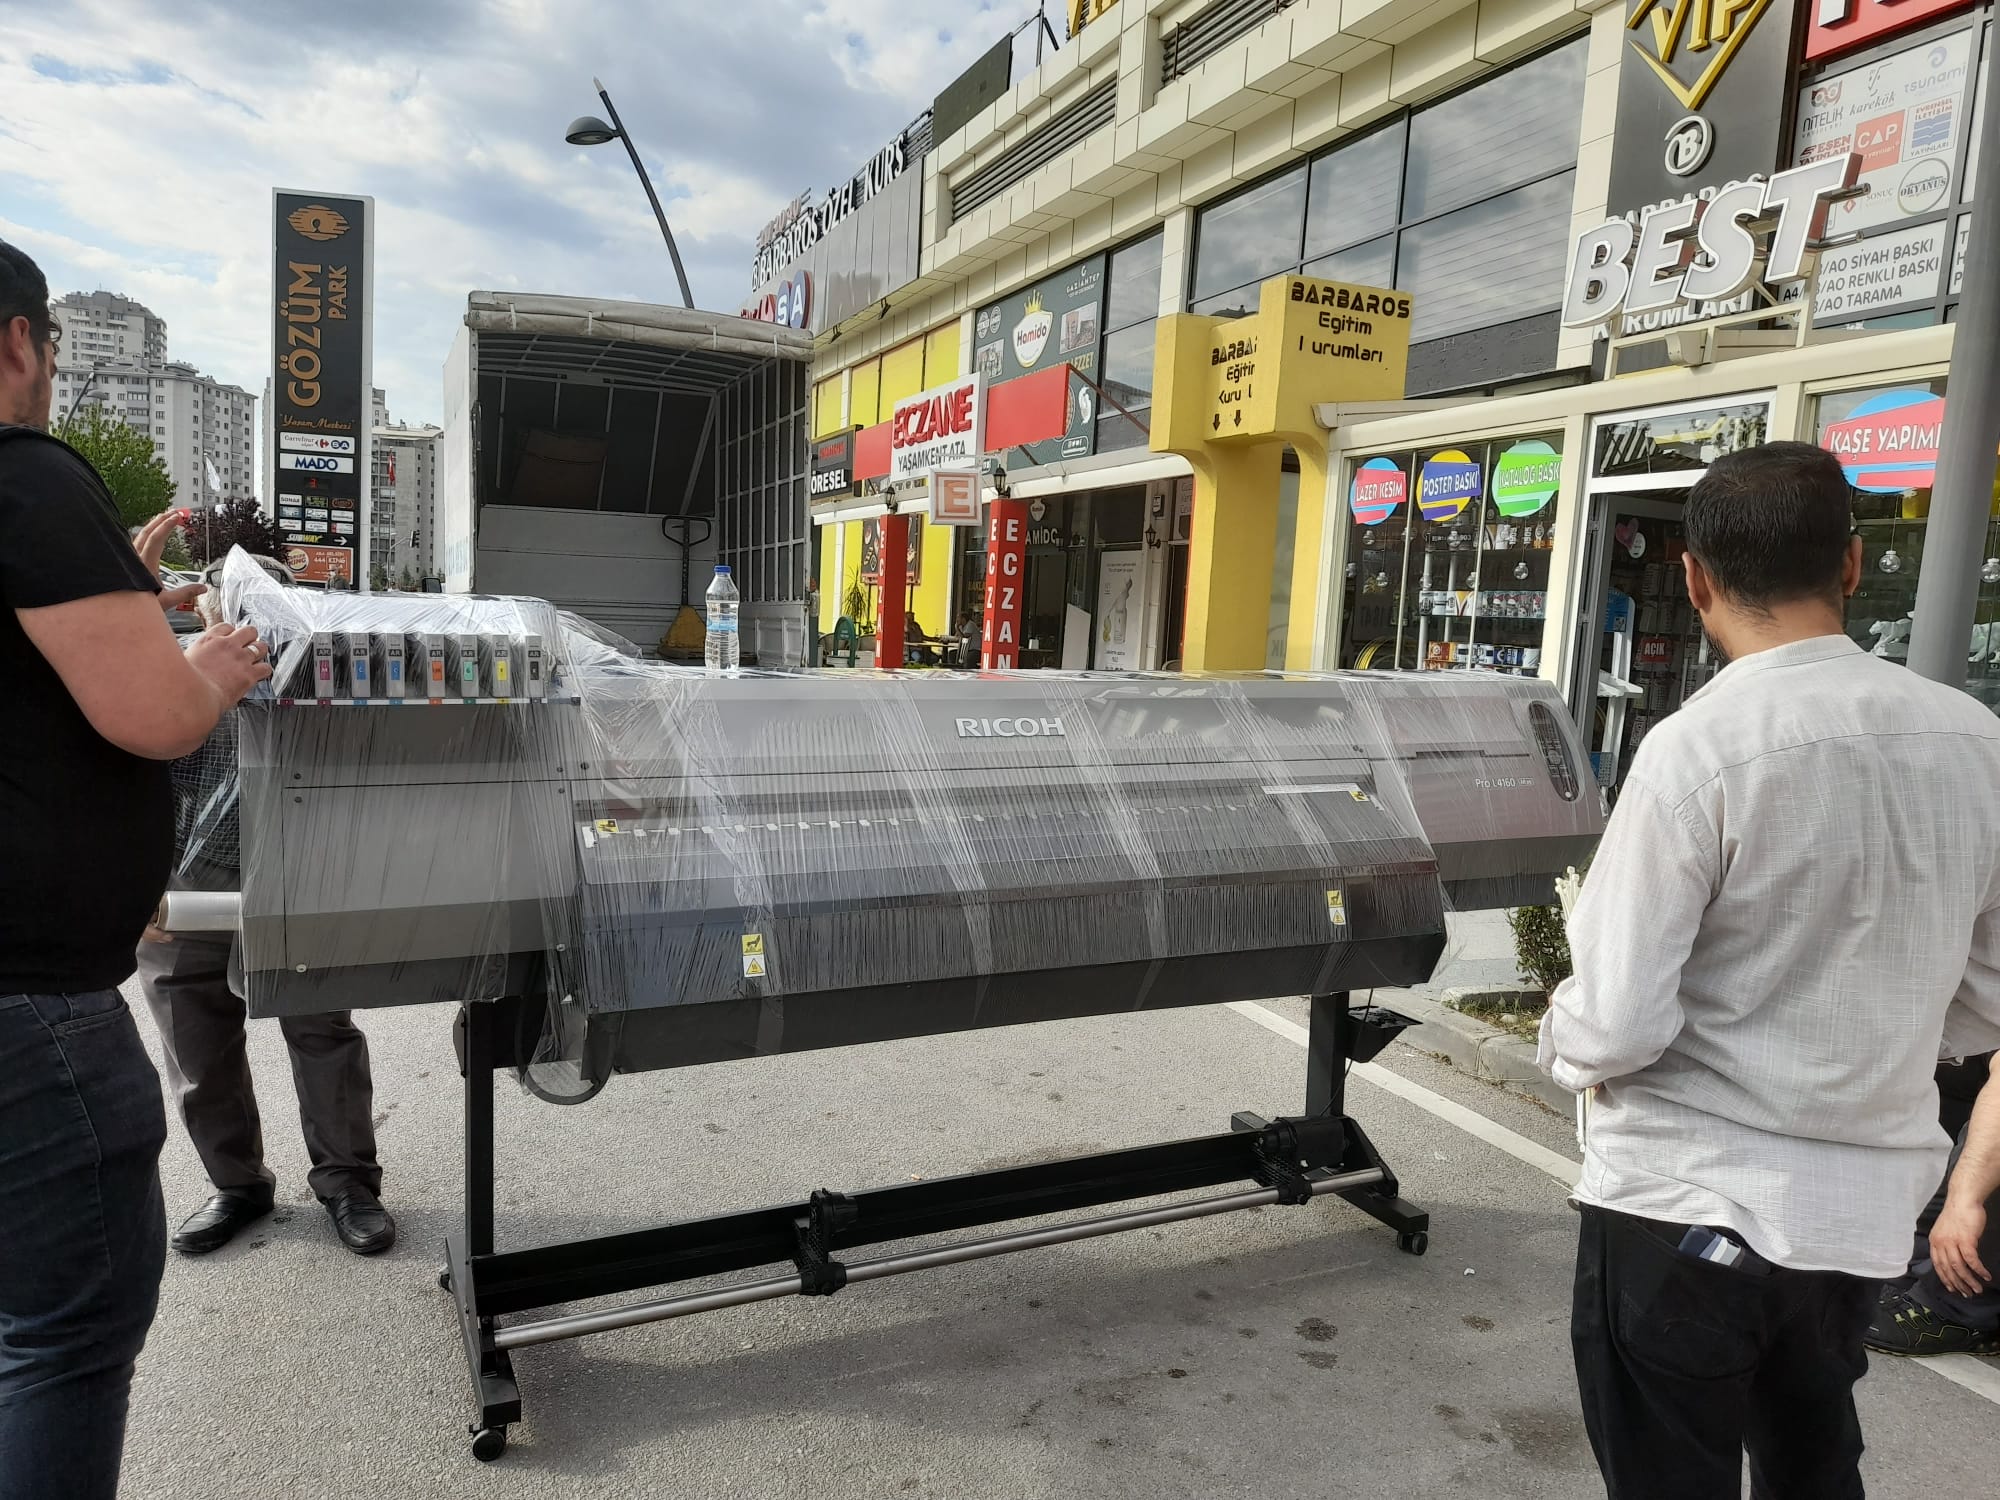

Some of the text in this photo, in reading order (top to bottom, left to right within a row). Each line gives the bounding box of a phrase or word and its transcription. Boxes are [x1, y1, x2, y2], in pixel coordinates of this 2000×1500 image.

[1650, 0, 1749, 63] VIP
[1904, 63, 1966, 93] tsunami
[1850, 91, 1895, 116] karekök
[1816, 134, 1851, 151] ESEN
[1857, 123, 1898, 149] CAP
[1910, 142, 1949, 157] YAYINLARI
[759, 209, 819, 288] BARBAROS
[822, 180, 856, 235] ÖZEL
[863, 133, 905, 203] KURS
[1561, 153, 1851, 328] BEST
[1851, 249, 1890, 269] SİYAH
[1893, 238, 1933, 260] BASKI
[1849, 261, 1895, 288] RENKLİ
[1898, 257, 1939, 278] BASKI
[328, 265, 347, 320] PARK
[1291, 281, 1410, 319] BARBAROS
[1847, 285, 1903, 308] TARAMA
[280, 261, 321, 407] GÖZÜM
[1017, 322, 1047, 347] Hamido
[893, 384, 974, 449] ECZANE
[1830, 422, 1942, 460] KAŞE YAPIMI
[295, 456, 338, 471] MADO
[898, 440, 966, 474] YAŞAMKENT ATA
[1423, 471, 1478, 497] POSTER BASKI
[1499, 465, 1535, 488] KATALOG
[944, 480, 968, 513] E
[1356, 484, 1378, 501] LAZER
[286, 533, 323, 543] SUBWAY
[955, 717, 1065, 737] RICOH
[1475, 778, 1490, 788] Pro
